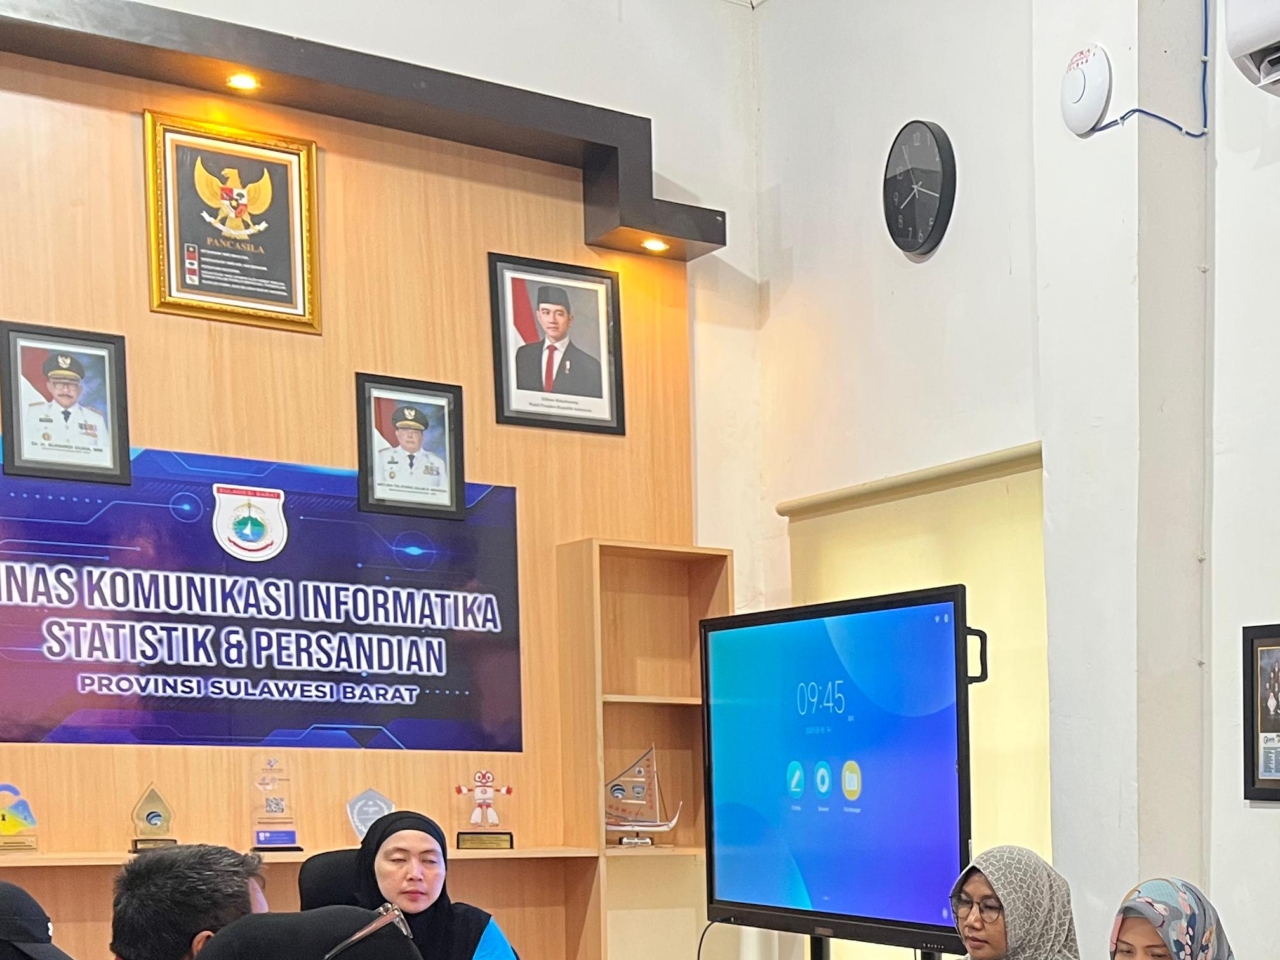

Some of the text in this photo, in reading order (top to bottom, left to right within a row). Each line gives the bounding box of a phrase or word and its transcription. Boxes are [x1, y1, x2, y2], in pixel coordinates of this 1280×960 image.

[206, 237, 265, 254] PANCASILA
[0, 564, 500, 630] NAS KOMUNIKASI INFORMATIKA
[45, 619, 445, 674] STATISTIK & PERSANDIAN
[79, 674, 418, 702] PROVINSI SULAWESI BARAT
[797, 680, 845, 715] 09:45
